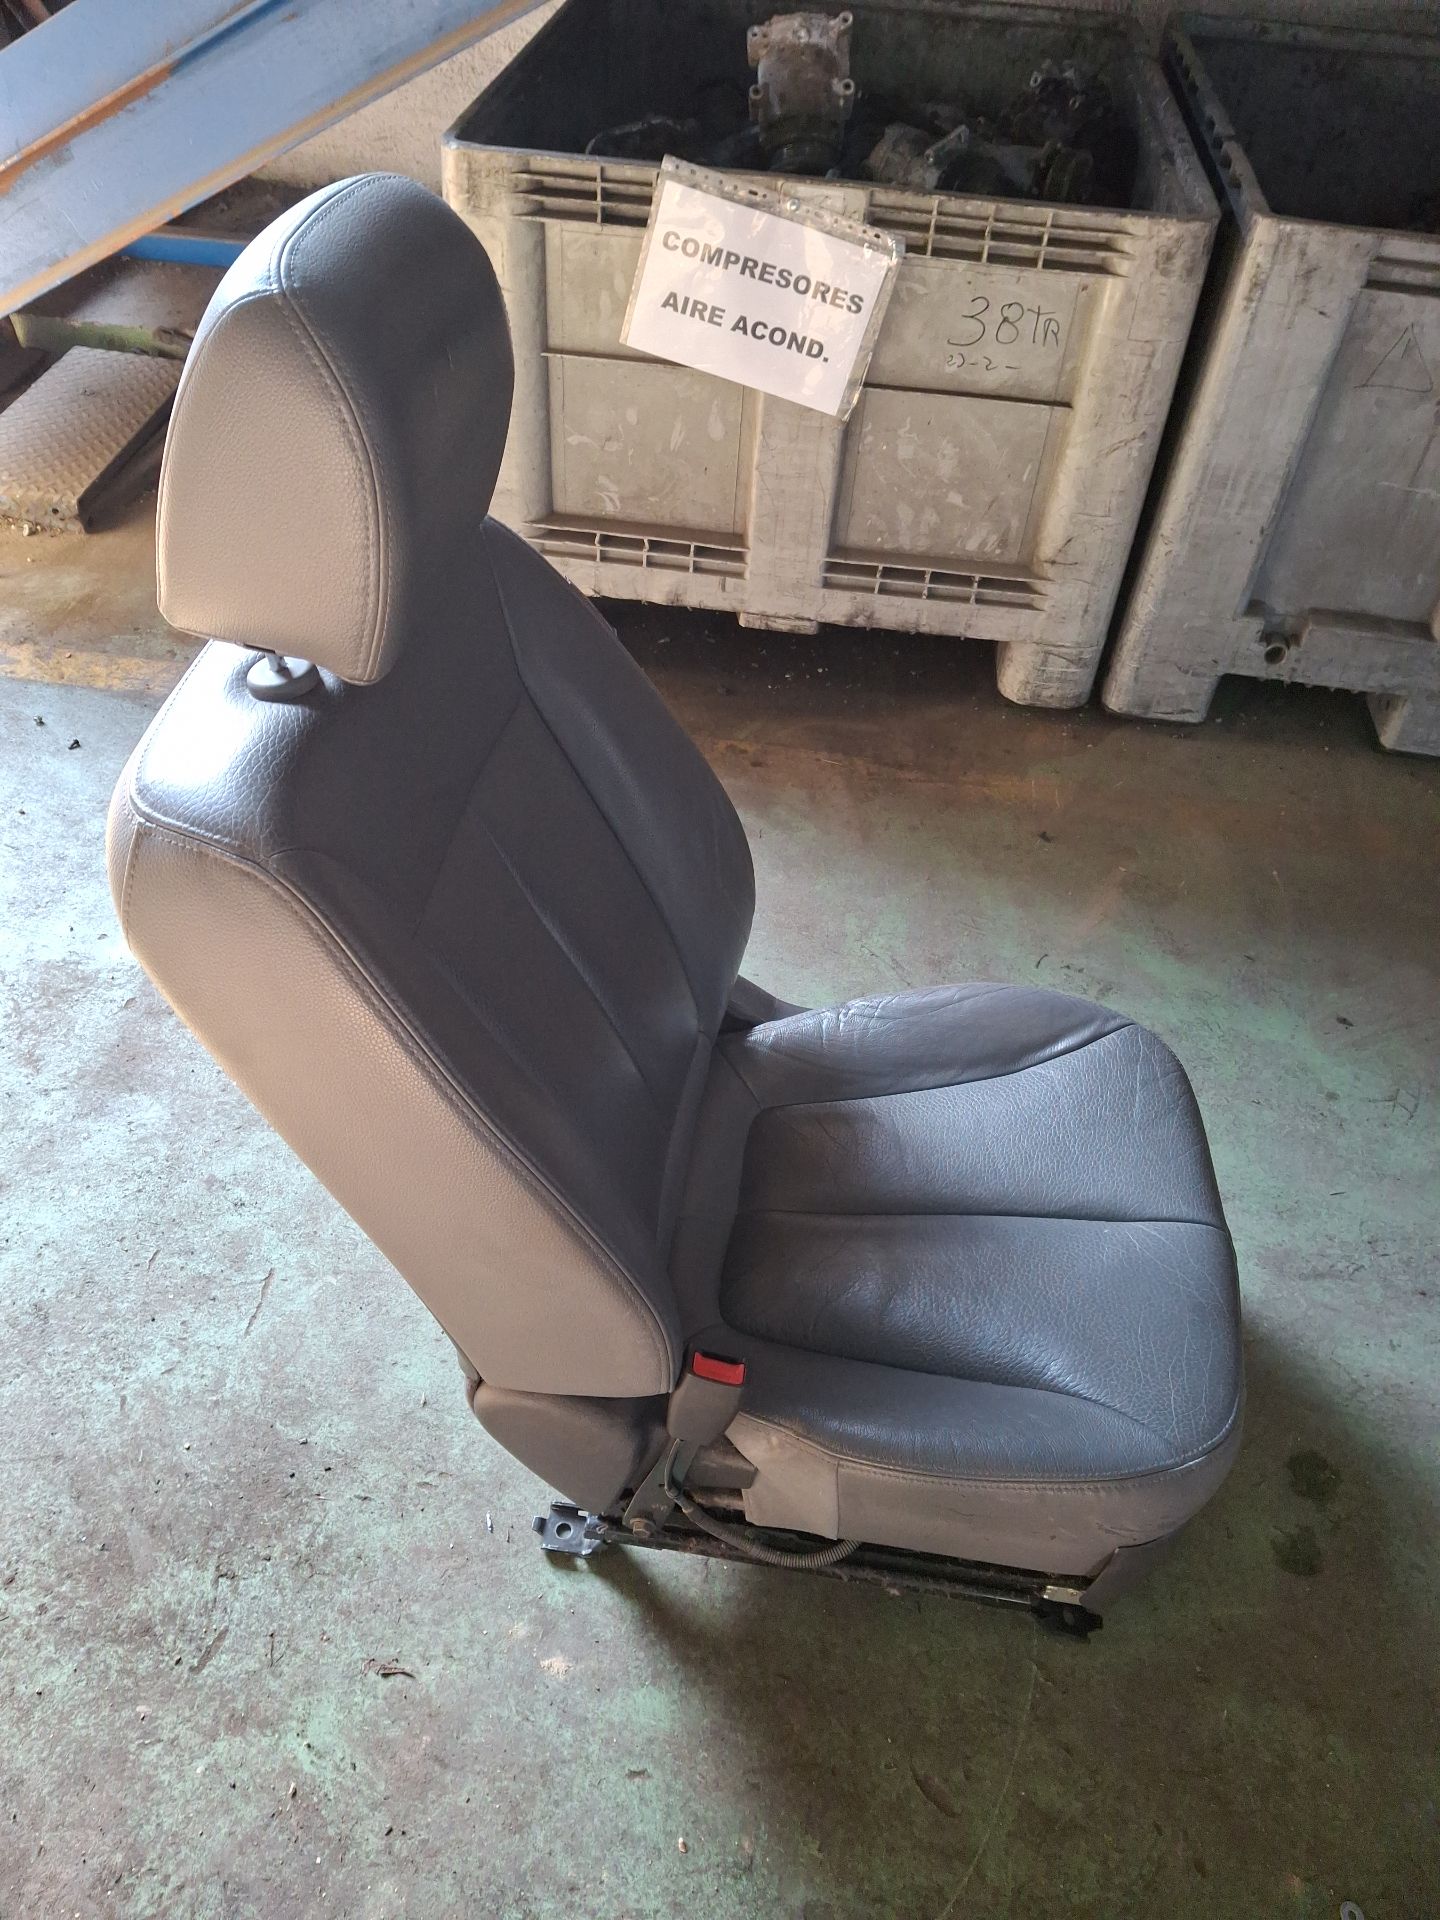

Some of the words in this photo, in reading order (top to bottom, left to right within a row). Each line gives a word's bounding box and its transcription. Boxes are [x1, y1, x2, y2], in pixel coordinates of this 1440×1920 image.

[661, 230, 865, 315] COMPRESORES
[660, 290, 726, 328] AIRE
[730, 314, 829, 363] ACOND.
